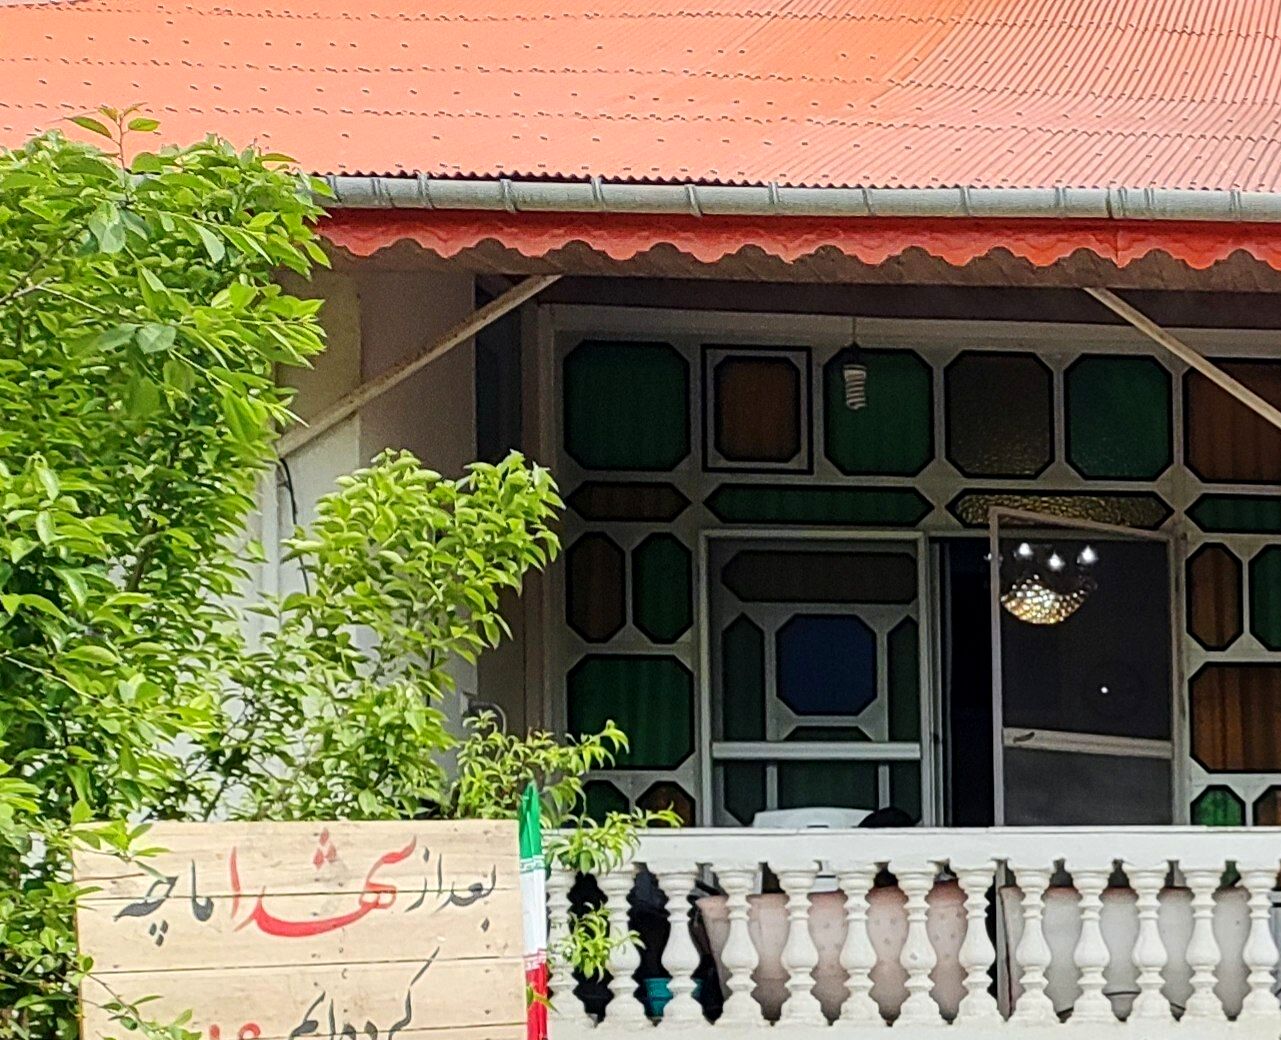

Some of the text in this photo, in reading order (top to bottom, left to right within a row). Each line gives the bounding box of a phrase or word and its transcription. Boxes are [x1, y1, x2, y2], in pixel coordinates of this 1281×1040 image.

[113, 827, 496, 947] بعد از شهدا ما چه
